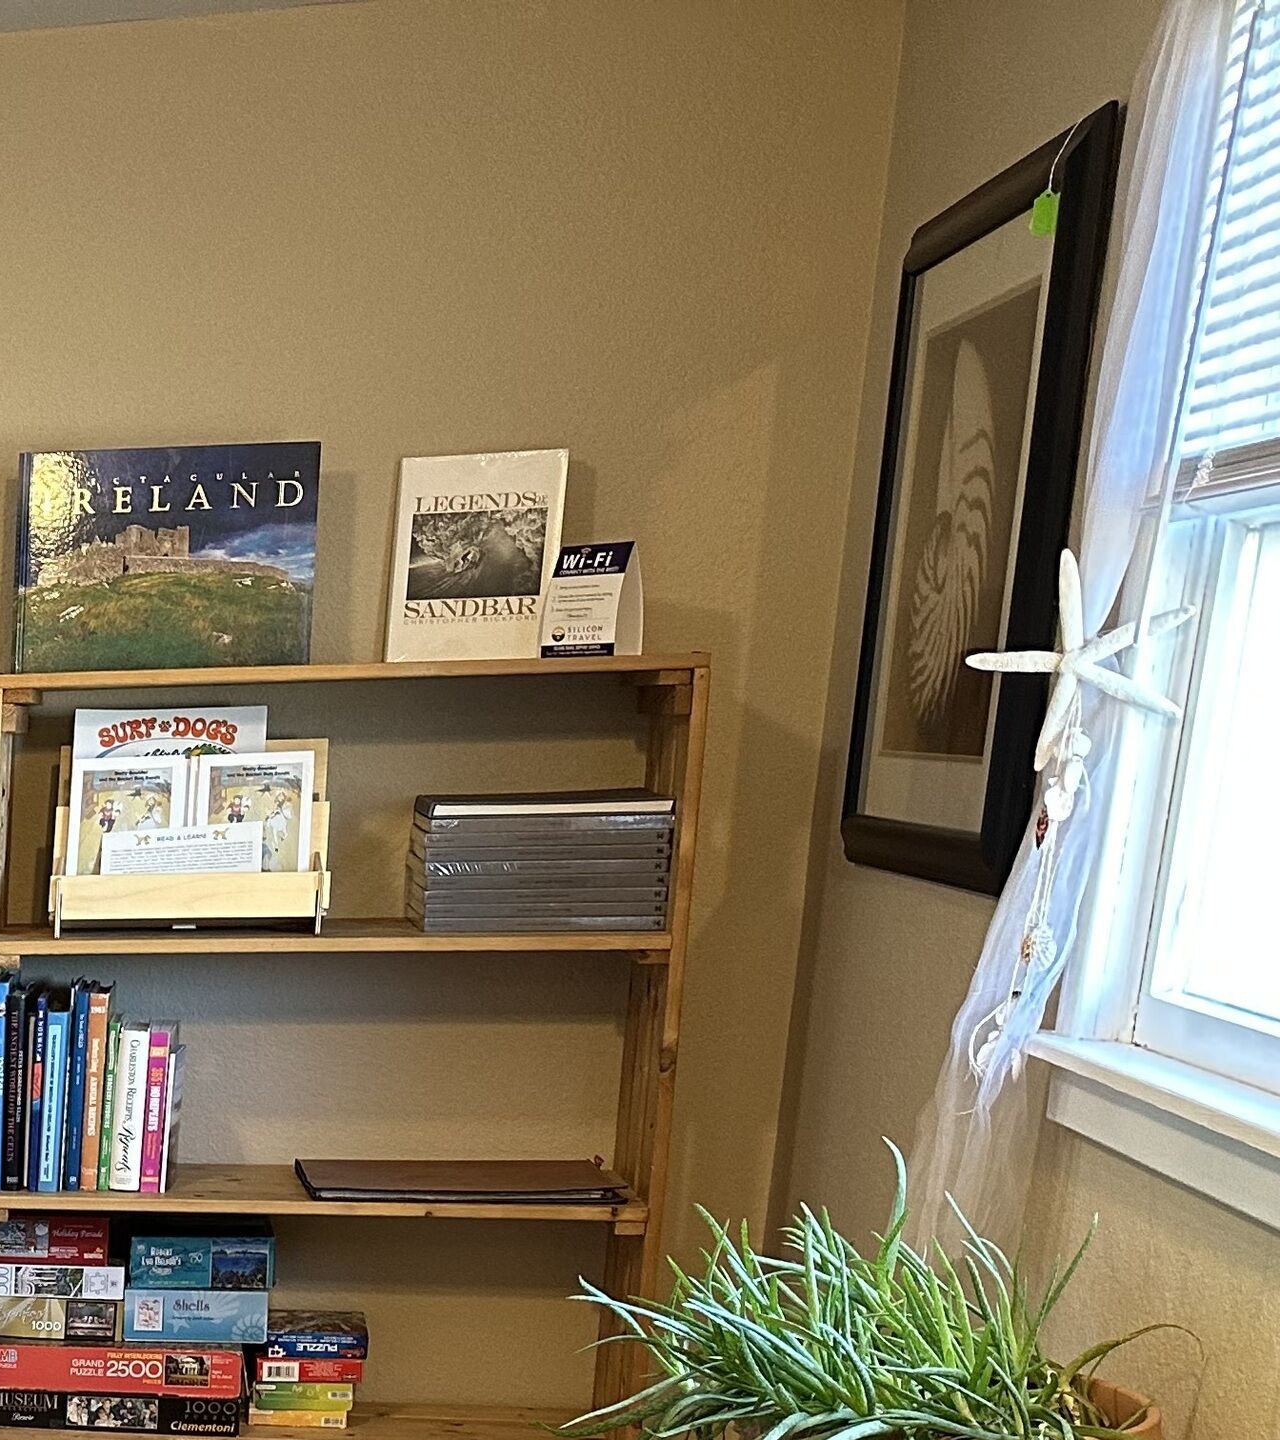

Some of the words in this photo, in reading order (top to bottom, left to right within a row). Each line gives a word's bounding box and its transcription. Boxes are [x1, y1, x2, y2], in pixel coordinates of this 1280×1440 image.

[415, 491, 537, 512] LEGENDS
[563, 551, 613, 569] Wi-Fi
[404, 597, 537, 619] SANDBAR
[403, 616, 478, 625] CHRISTOPHER
[483, 614, 538, 622] BICKFORD
[567, 625, 603, 633] SILICON
[567, 633, 602, 641] TRAVEL
[98, 716, 157, 747] SURF
[171, 716, 238, 745] DOG'S
[9, 1031, 18, 1068] ANCIENT
[127, 1040, 140, 1086] CHARLESTON
[8, 1070, 16, 1102] WORLD
[150, 1086, 161, 1098] NO
[8, 1103, 15, 1114] OF
[148, 1098, 160, 1131] REPEATS
[7, 1116, 15, 1134] THE
[6, 1136, 14, 1162] CELTS
[52, 1229, 79, 1239] Holiday
[81, 1229, 105, 1238] Parade
[173, 1299, 210, 1312] Shells
[31, 1321, 62, 1331] 1000
[296, 1343, 338, 1352] PUZZLE
[70, 1367, 104, 1377] PUZZLE
[106, 1360, 164, 1379] 2500
[72, 1359, 105, 1368] GRAND
[184, 1401, 237, 1414] 1000
[170, 1421, 235, 1433] Clementoni
